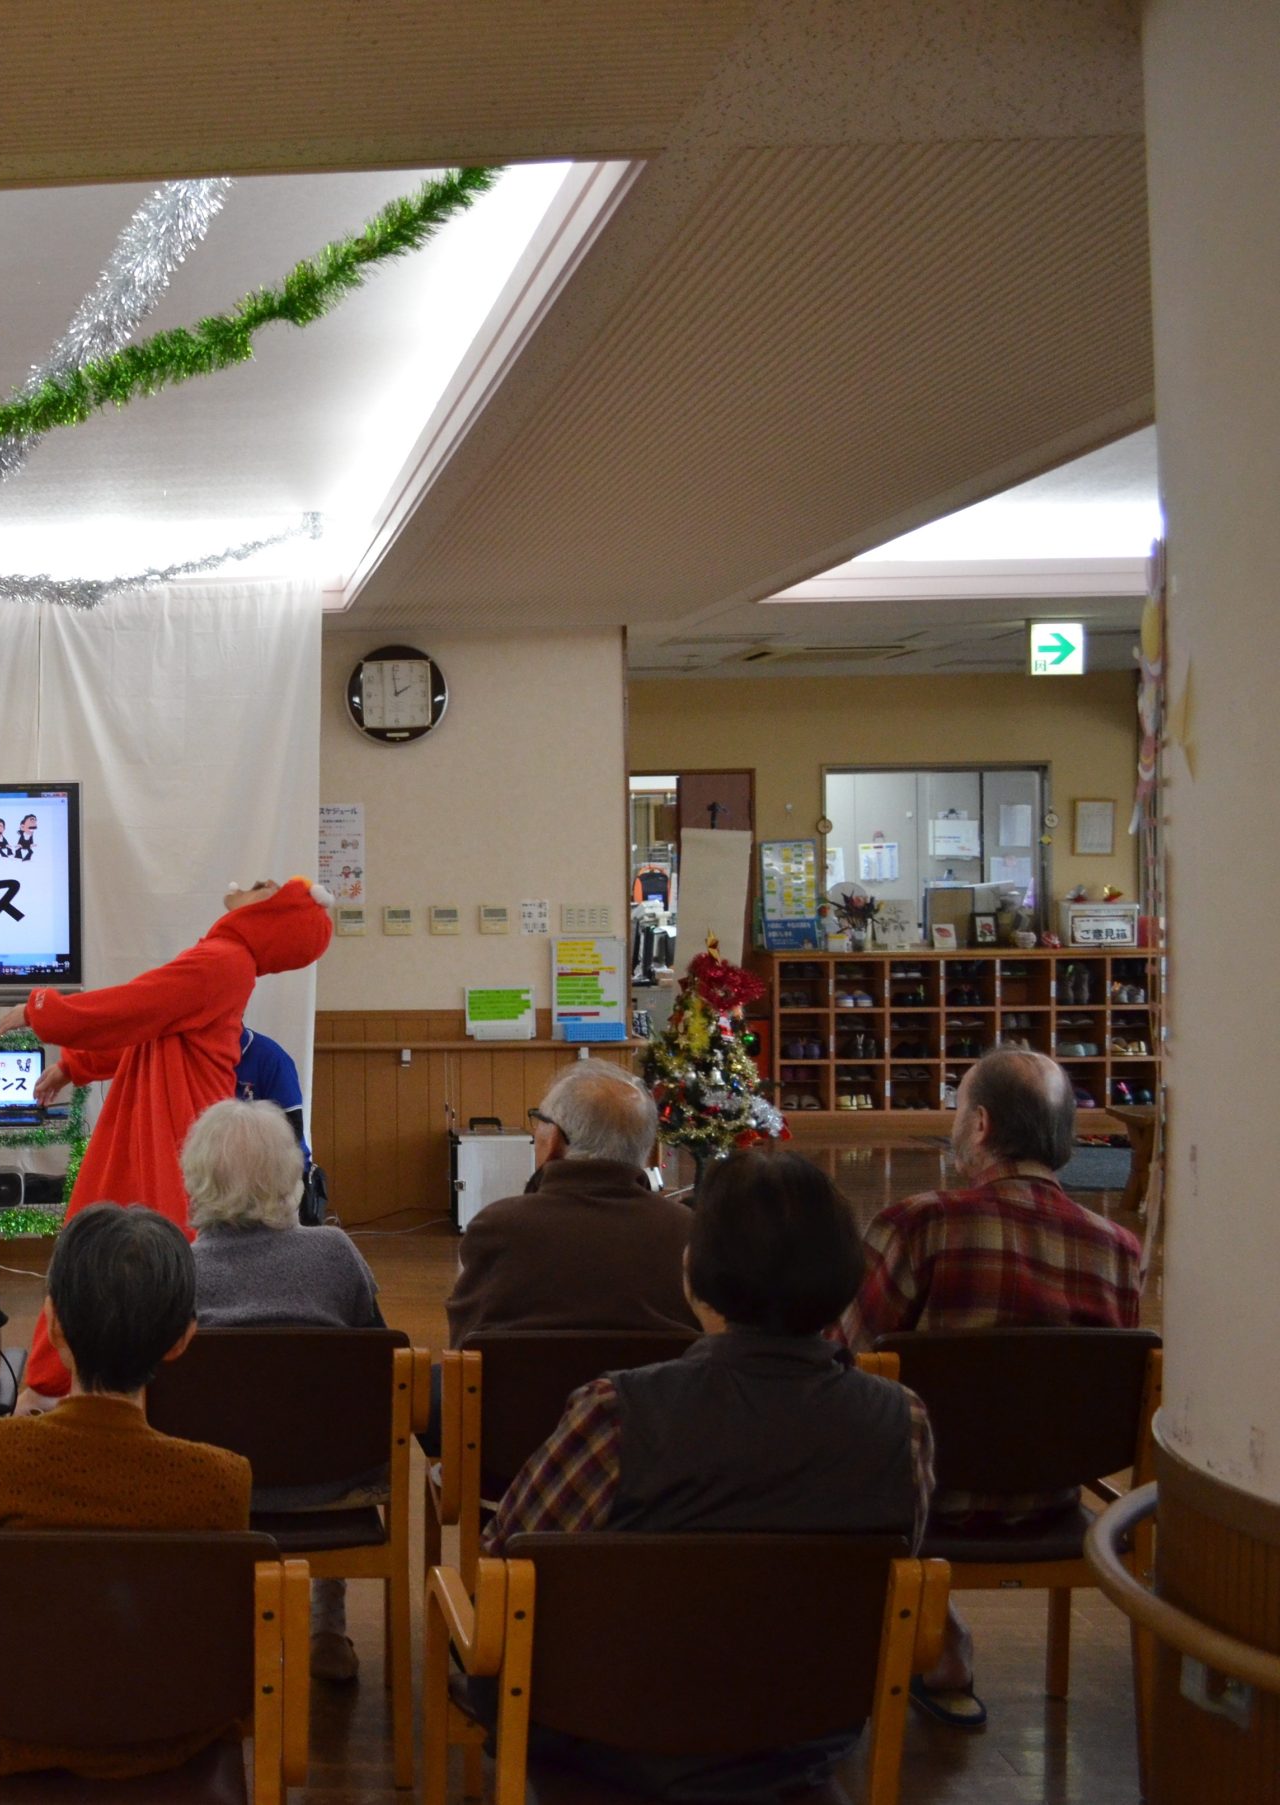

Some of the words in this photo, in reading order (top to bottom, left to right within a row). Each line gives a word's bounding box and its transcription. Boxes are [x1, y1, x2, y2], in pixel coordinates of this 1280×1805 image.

[319, 807, 358, 815] スケジュール
[1080, 928, 1127, 940] ご意見箱
